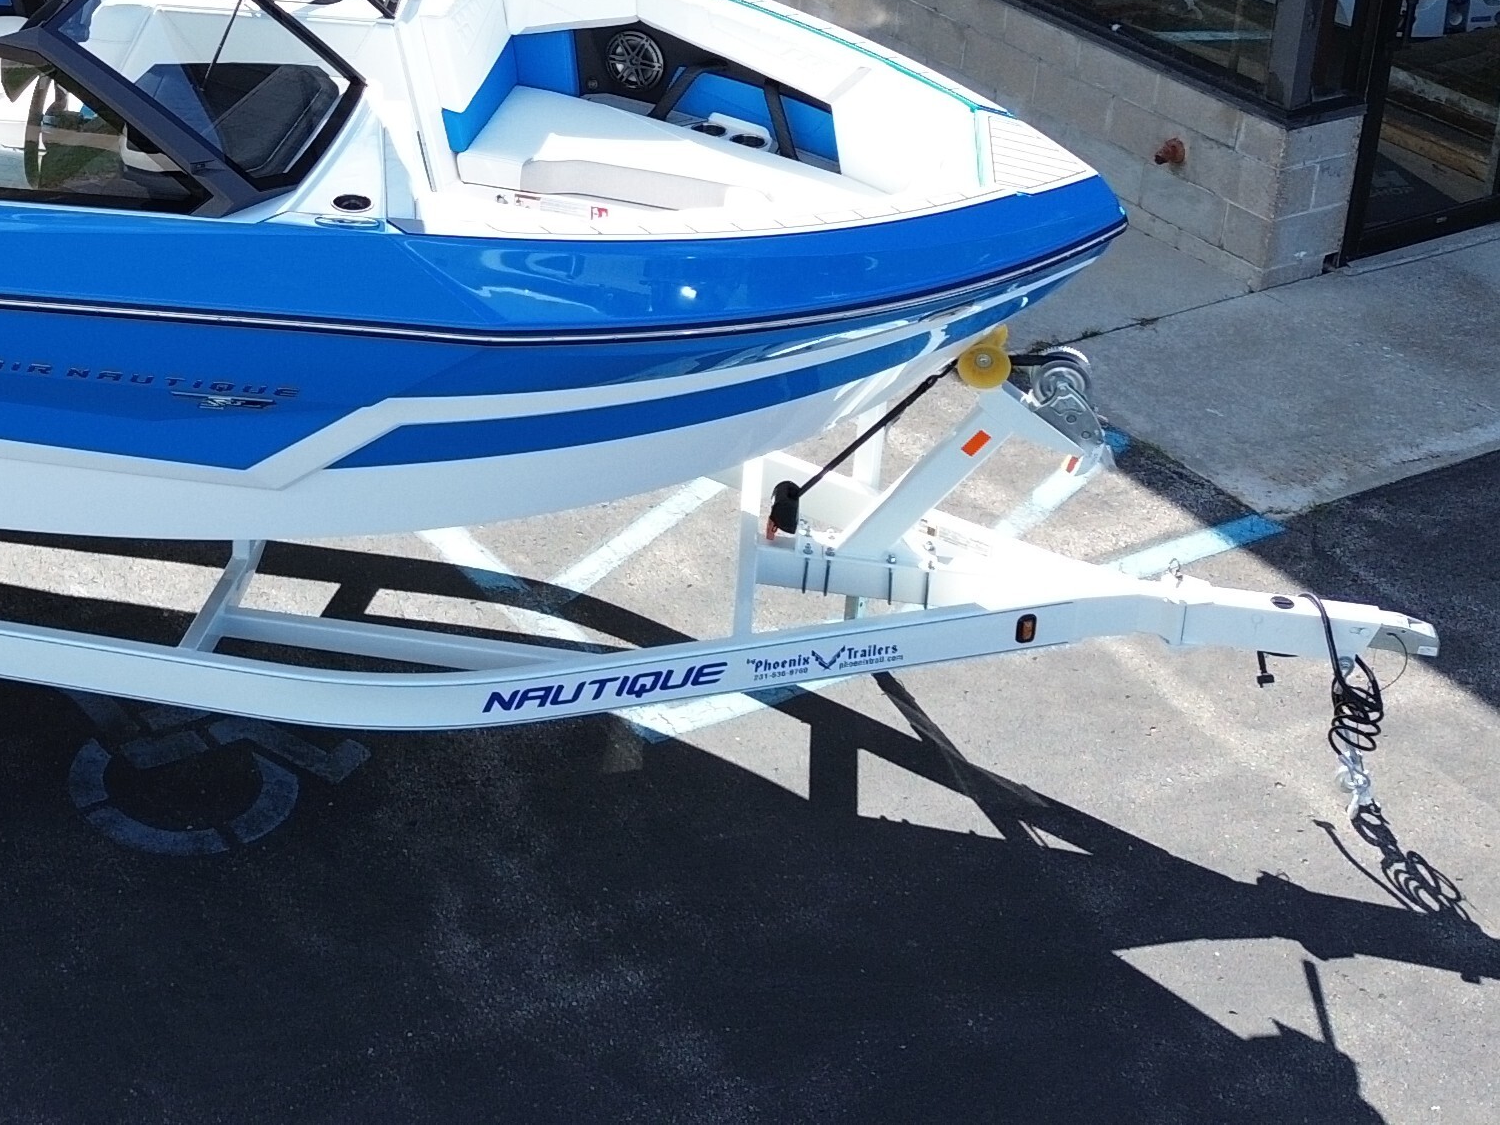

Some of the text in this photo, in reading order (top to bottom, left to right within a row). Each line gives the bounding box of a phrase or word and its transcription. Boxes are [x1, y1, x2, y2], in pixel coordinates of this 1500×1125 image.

[66, 367, 300, 397] NAUTIQUE
[754, 654, 810, 673] Phoenix
[847, 644, 898, 660] Trailers
[483, 661, 728, 713] NAUTIQUE
